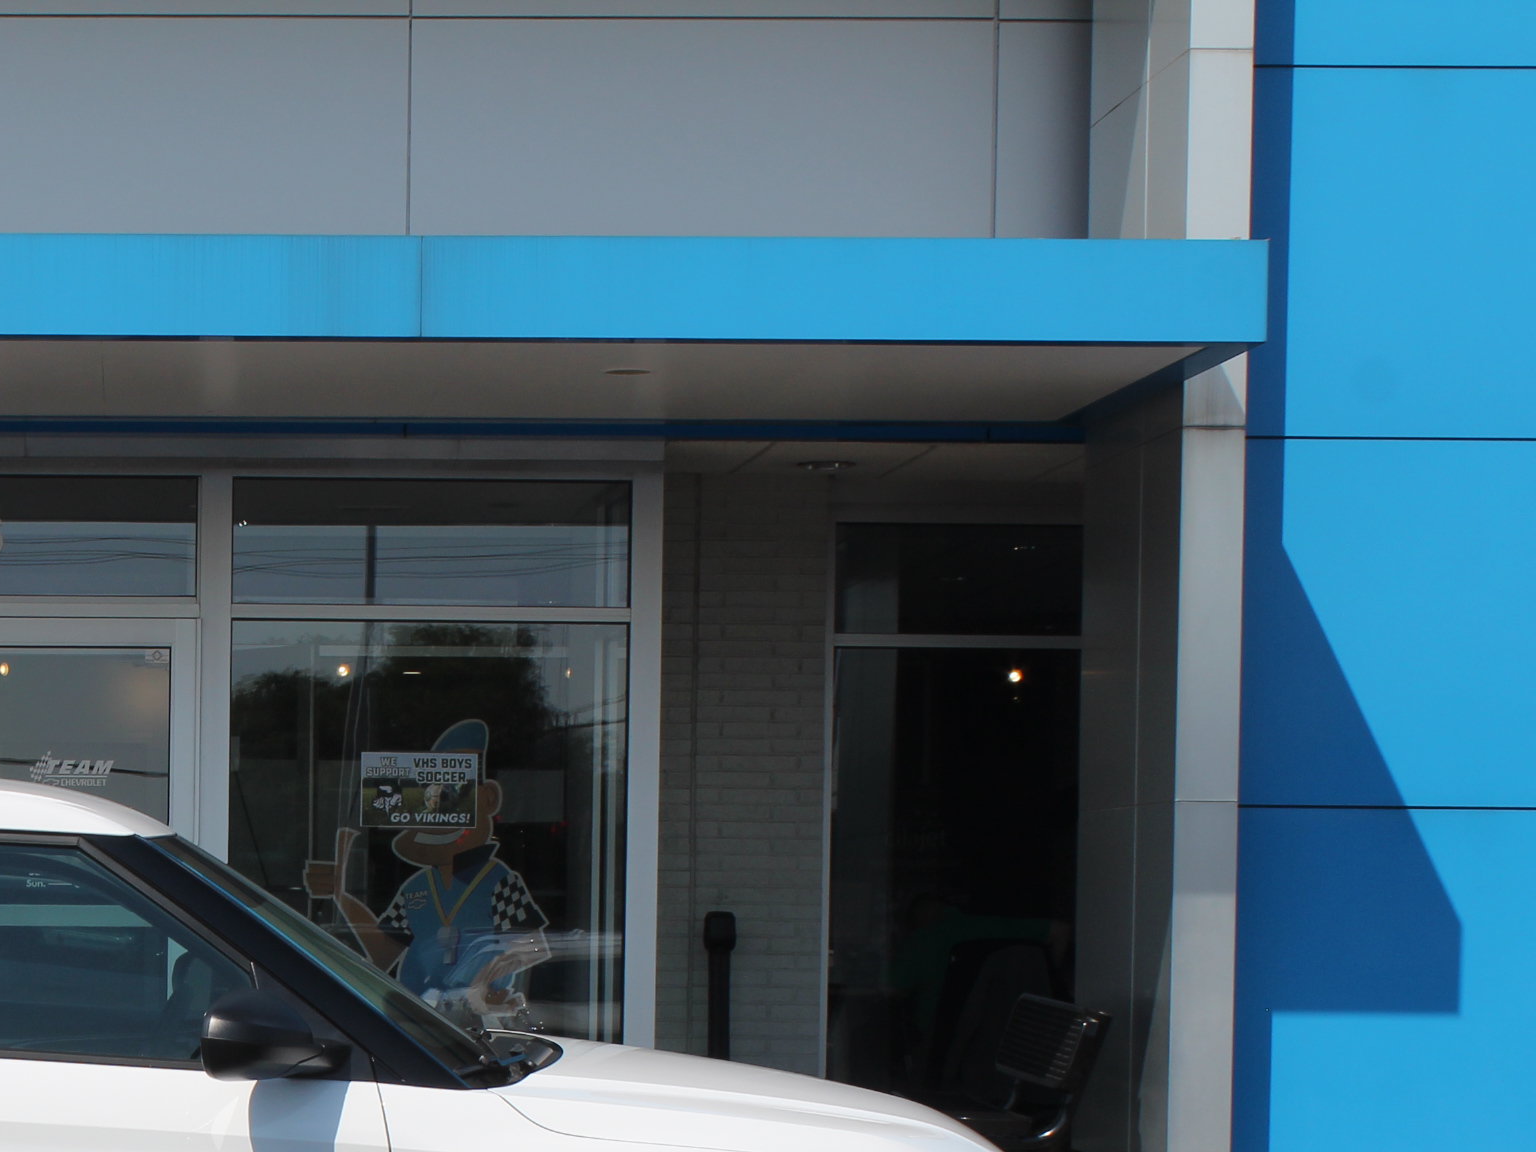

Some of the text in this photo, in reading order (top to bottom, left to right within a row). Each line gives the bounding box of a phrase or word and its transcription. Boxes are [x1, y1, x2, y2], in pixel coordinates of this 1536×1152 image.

[47, 760, 114, 774] TEAM
[380, 757, 397, 767] WE
[413, 757, 472, 769] VHS BOYS
[366, 768, 410, 776] SUPPORT
[417, 771, 467, 783] SOCCER
[61, 778, 107, 787] CHEVROLET
[390, 812, 471, 824] GO VIKINGS!
[25, 878, 47, 888] Sun.
[405, 890, 428, 899] TEAM
